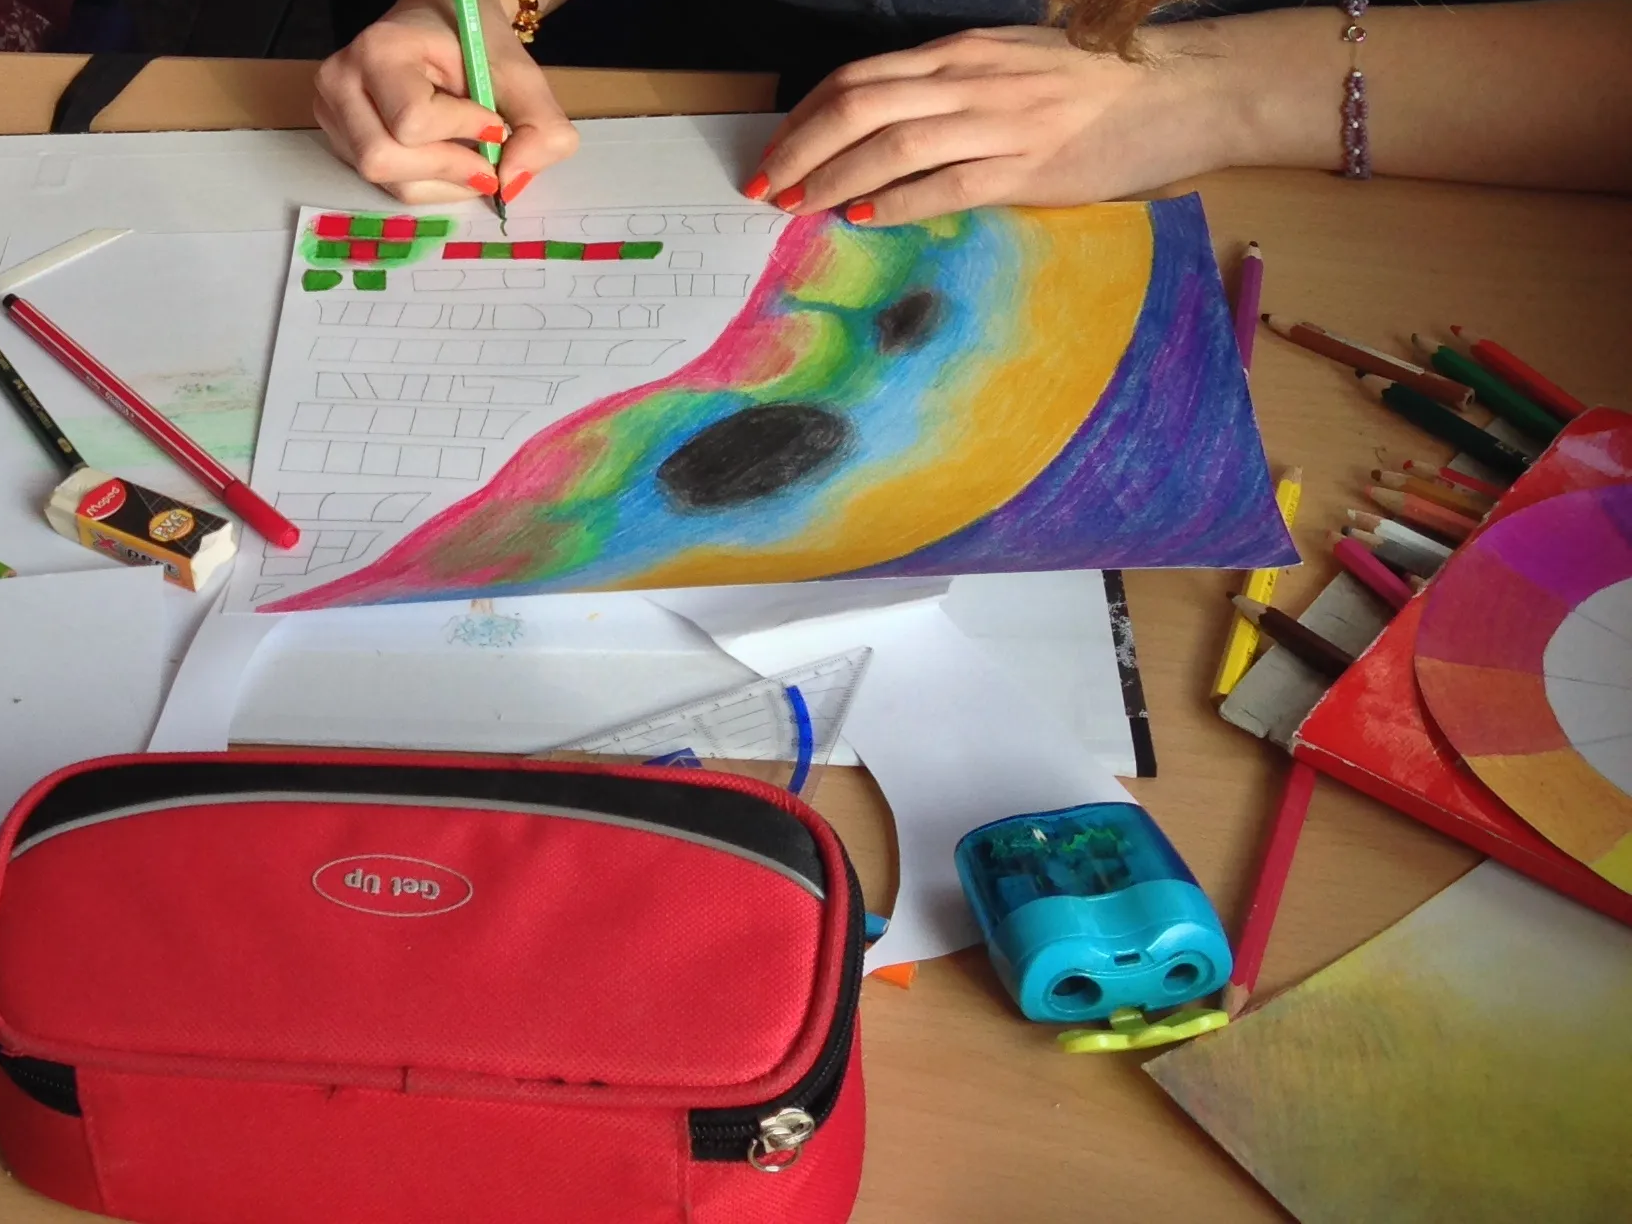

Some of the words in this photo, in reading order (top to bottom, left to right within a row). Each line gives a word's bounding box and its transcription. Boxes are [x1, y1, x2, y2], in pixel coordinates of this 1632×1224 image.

[86, 485, 121, 517] Maped
[344, 868, 381, 895] Up
[391, 875, 440, 900] Get
